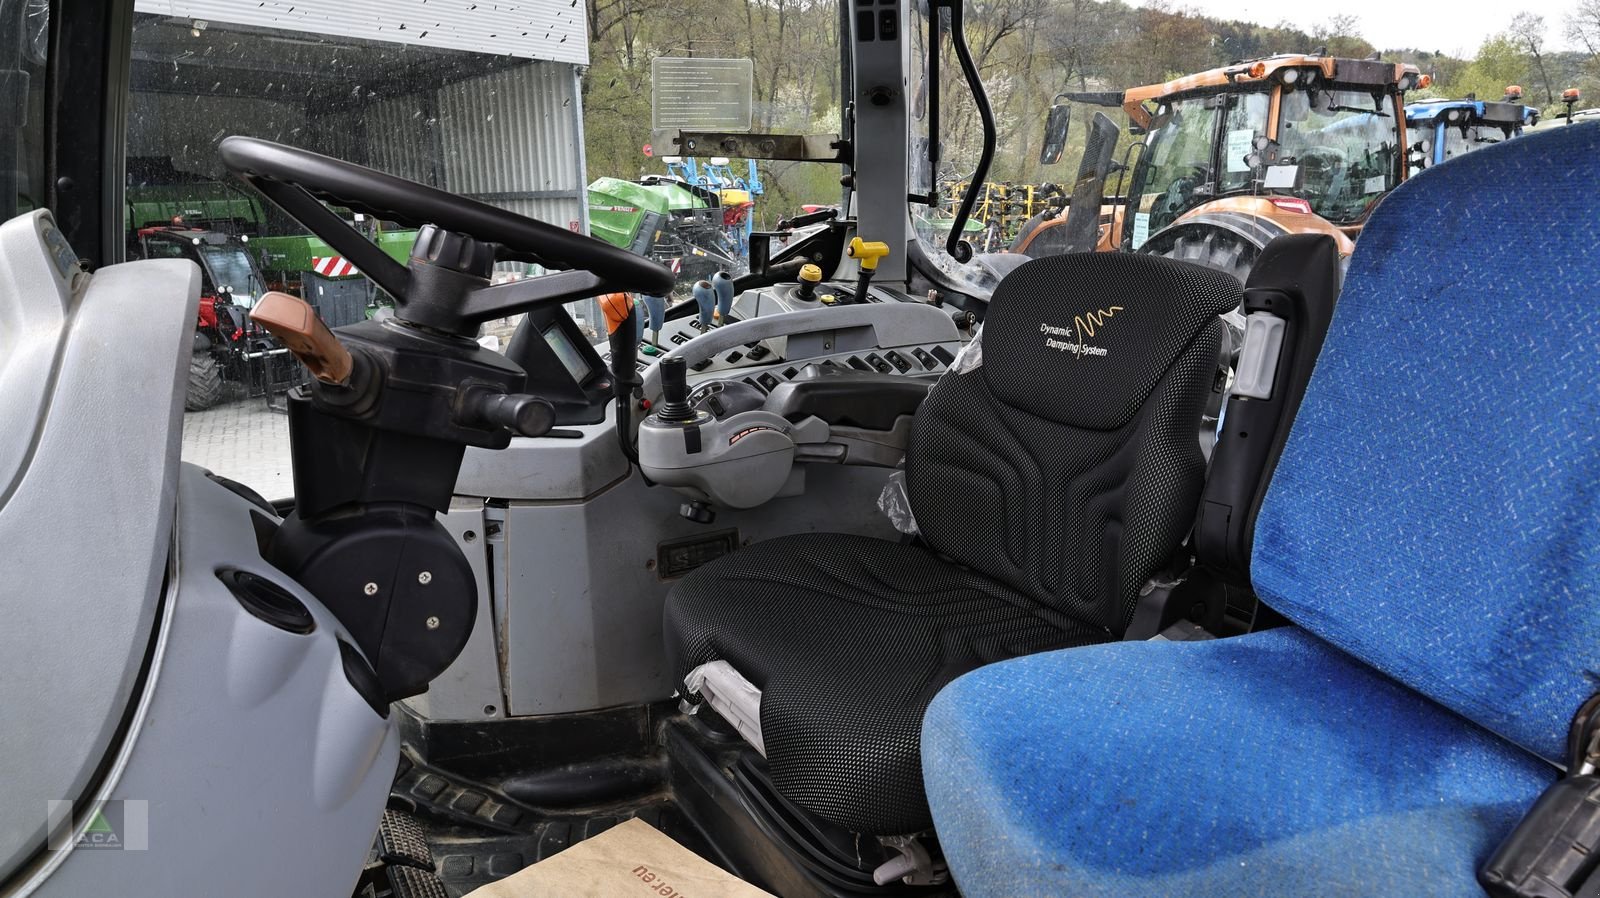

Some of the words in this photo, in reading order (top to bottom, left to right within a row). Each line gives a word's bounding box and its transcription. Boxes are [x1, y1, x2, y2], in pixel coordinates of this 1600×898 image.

[1040, 323, 1072, 336] Dynamic
[1046, 338, 1079, 354] Damping
[1081, 344, 1108, 357] System
